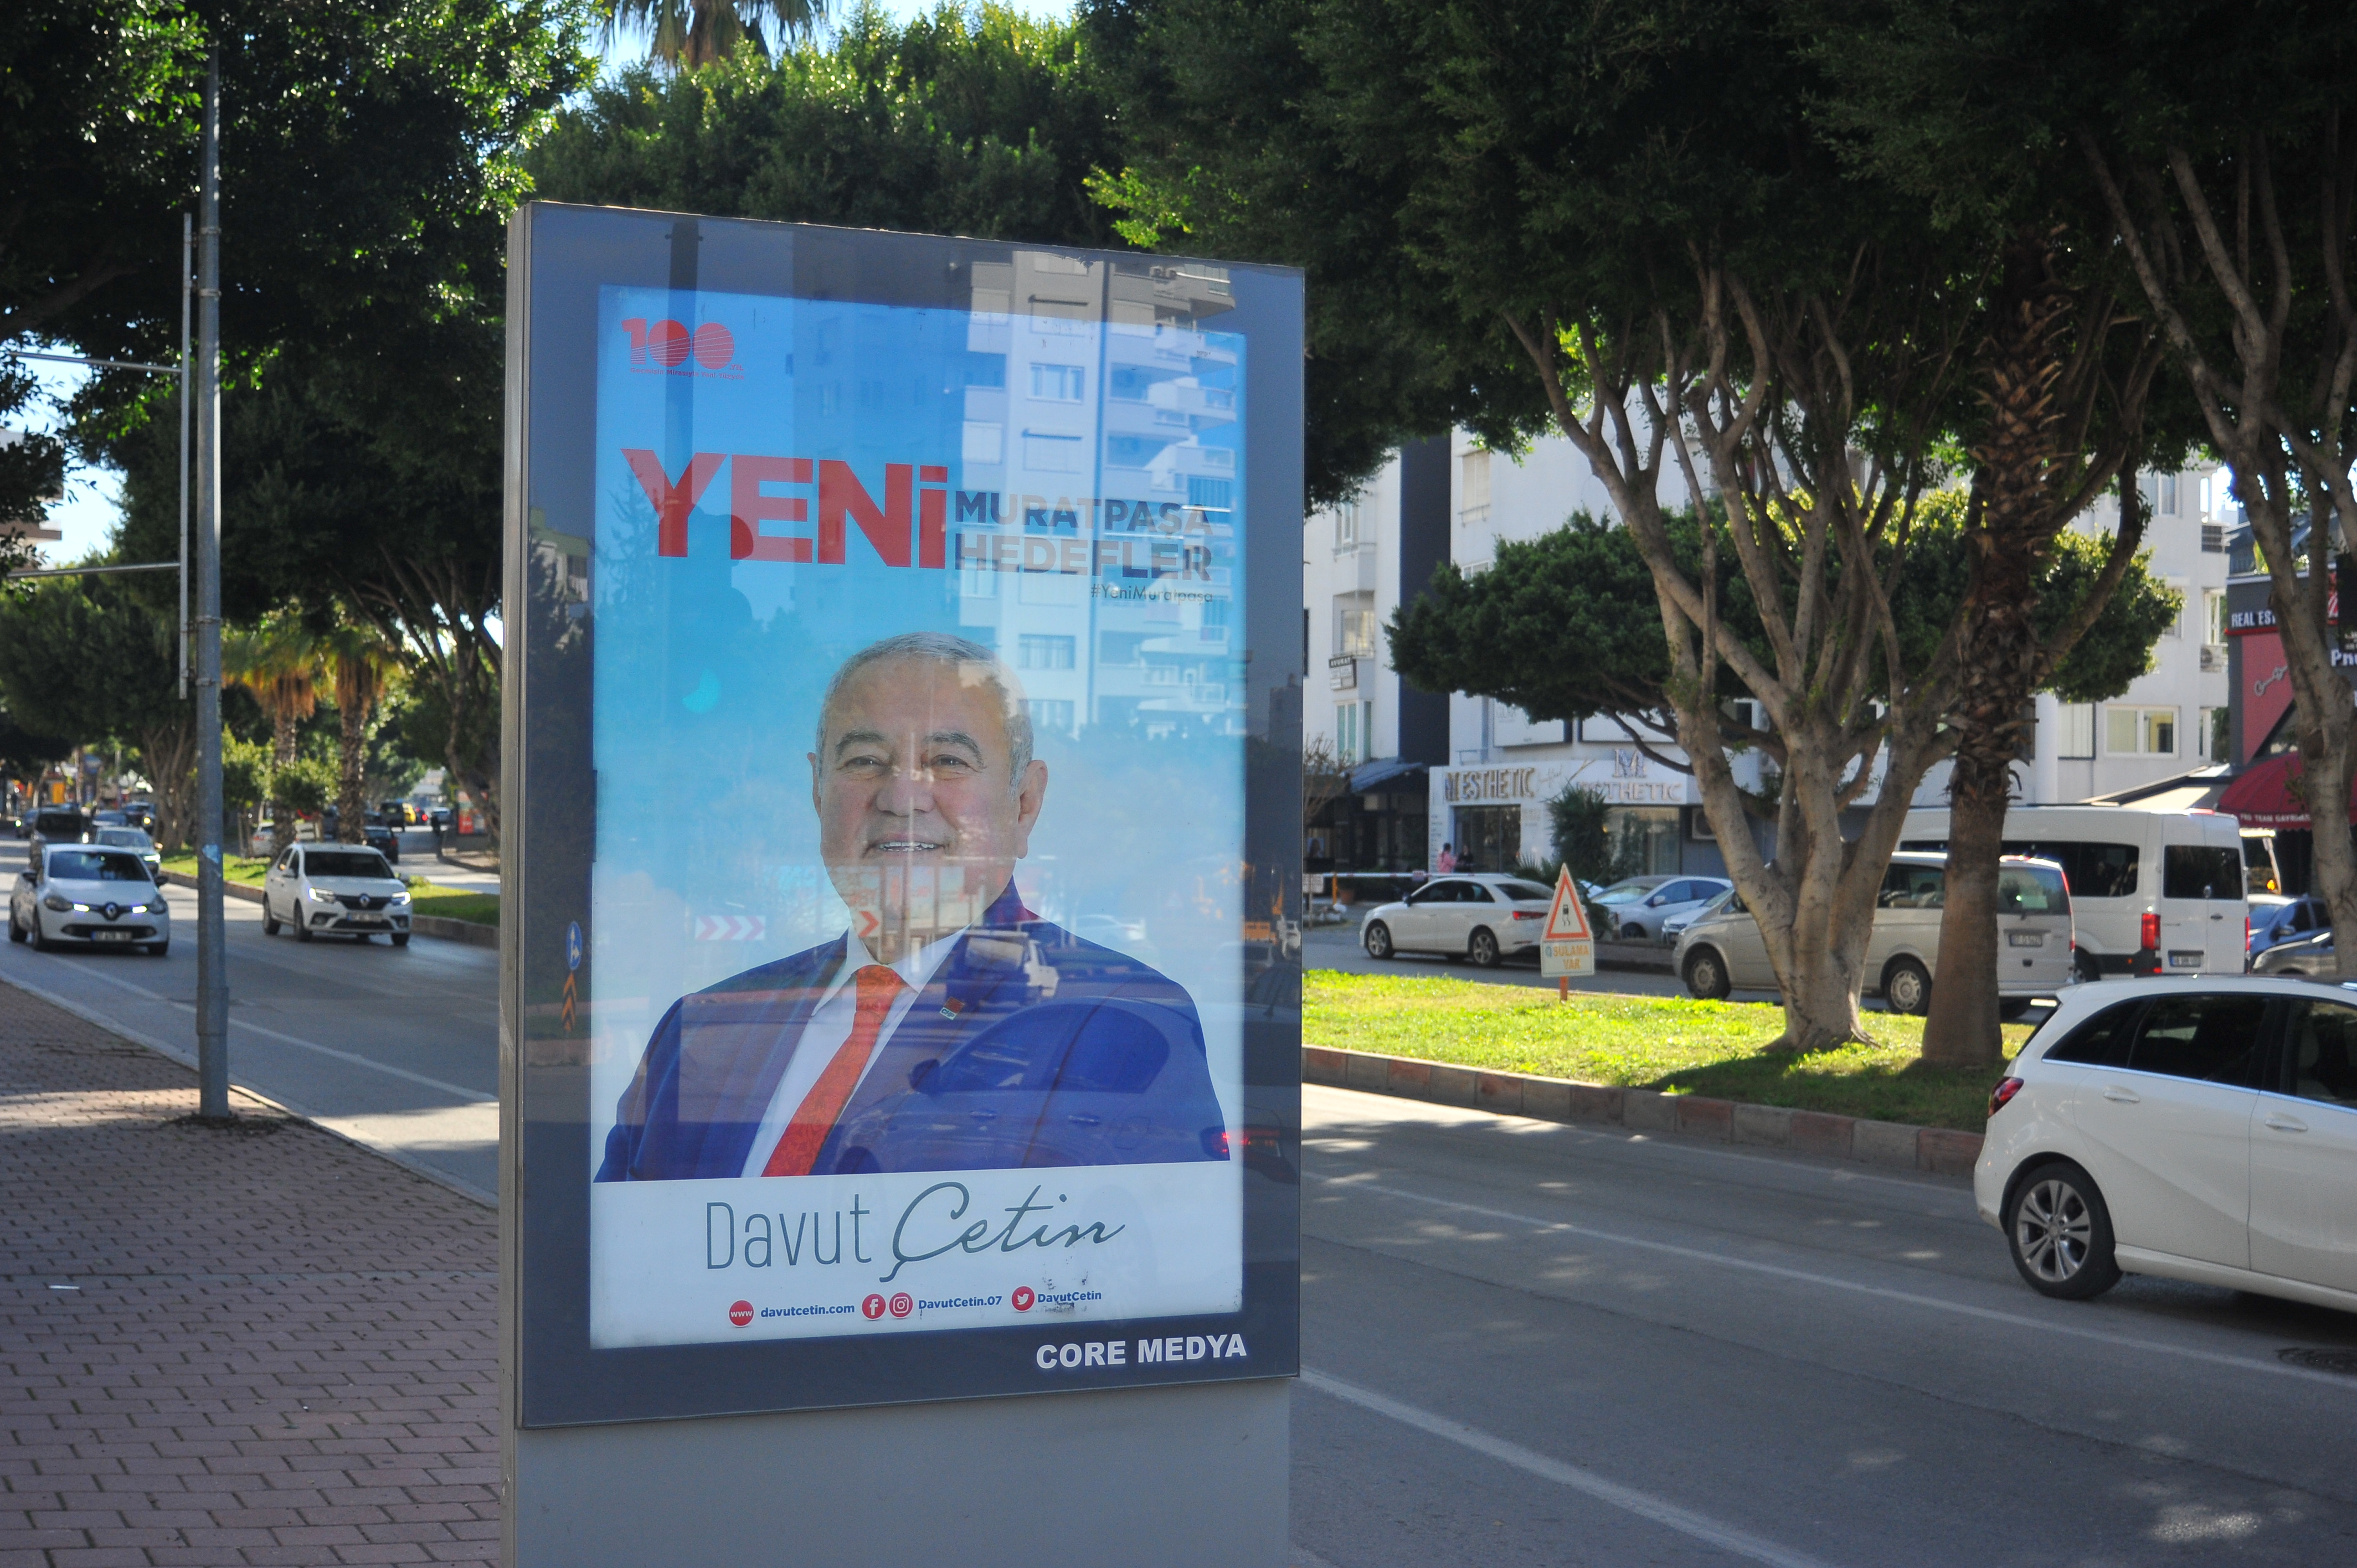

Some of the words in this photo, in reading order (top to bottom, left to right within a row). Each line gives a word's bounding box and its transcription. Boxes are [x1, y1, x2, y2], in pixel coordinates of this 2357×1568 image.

[621, 318, 735, 369] 100
[954, 491, 1214, 539] MURATPAŞA
[954, 533, 1213, 581] HEDEFLER
[1090, 583, 1213, 606] #YeniMuratpaşa
[2231, 612, 2255, 627] REAL
[1553, 945, 1589, 957] SULAMA
[1563, 958, 1581, 969] VAR
[941, 1008, 955, 1017] CHP
[706, 1193, 872, 1270] Davut
[878, 1181, 1126, 1283] Çetin
[730, 1309, 753, 1318] www
[760, 1304, 855, 1318] davutcetin.com
[918, 1295, 1002, 1309] DavutCetin.07
[1037, 1290, 1102, 1303] DavutCetin
[1036, 1340, 1126, 1369] CORE
[1138, 1333, 1247, 1363] MEDYA
